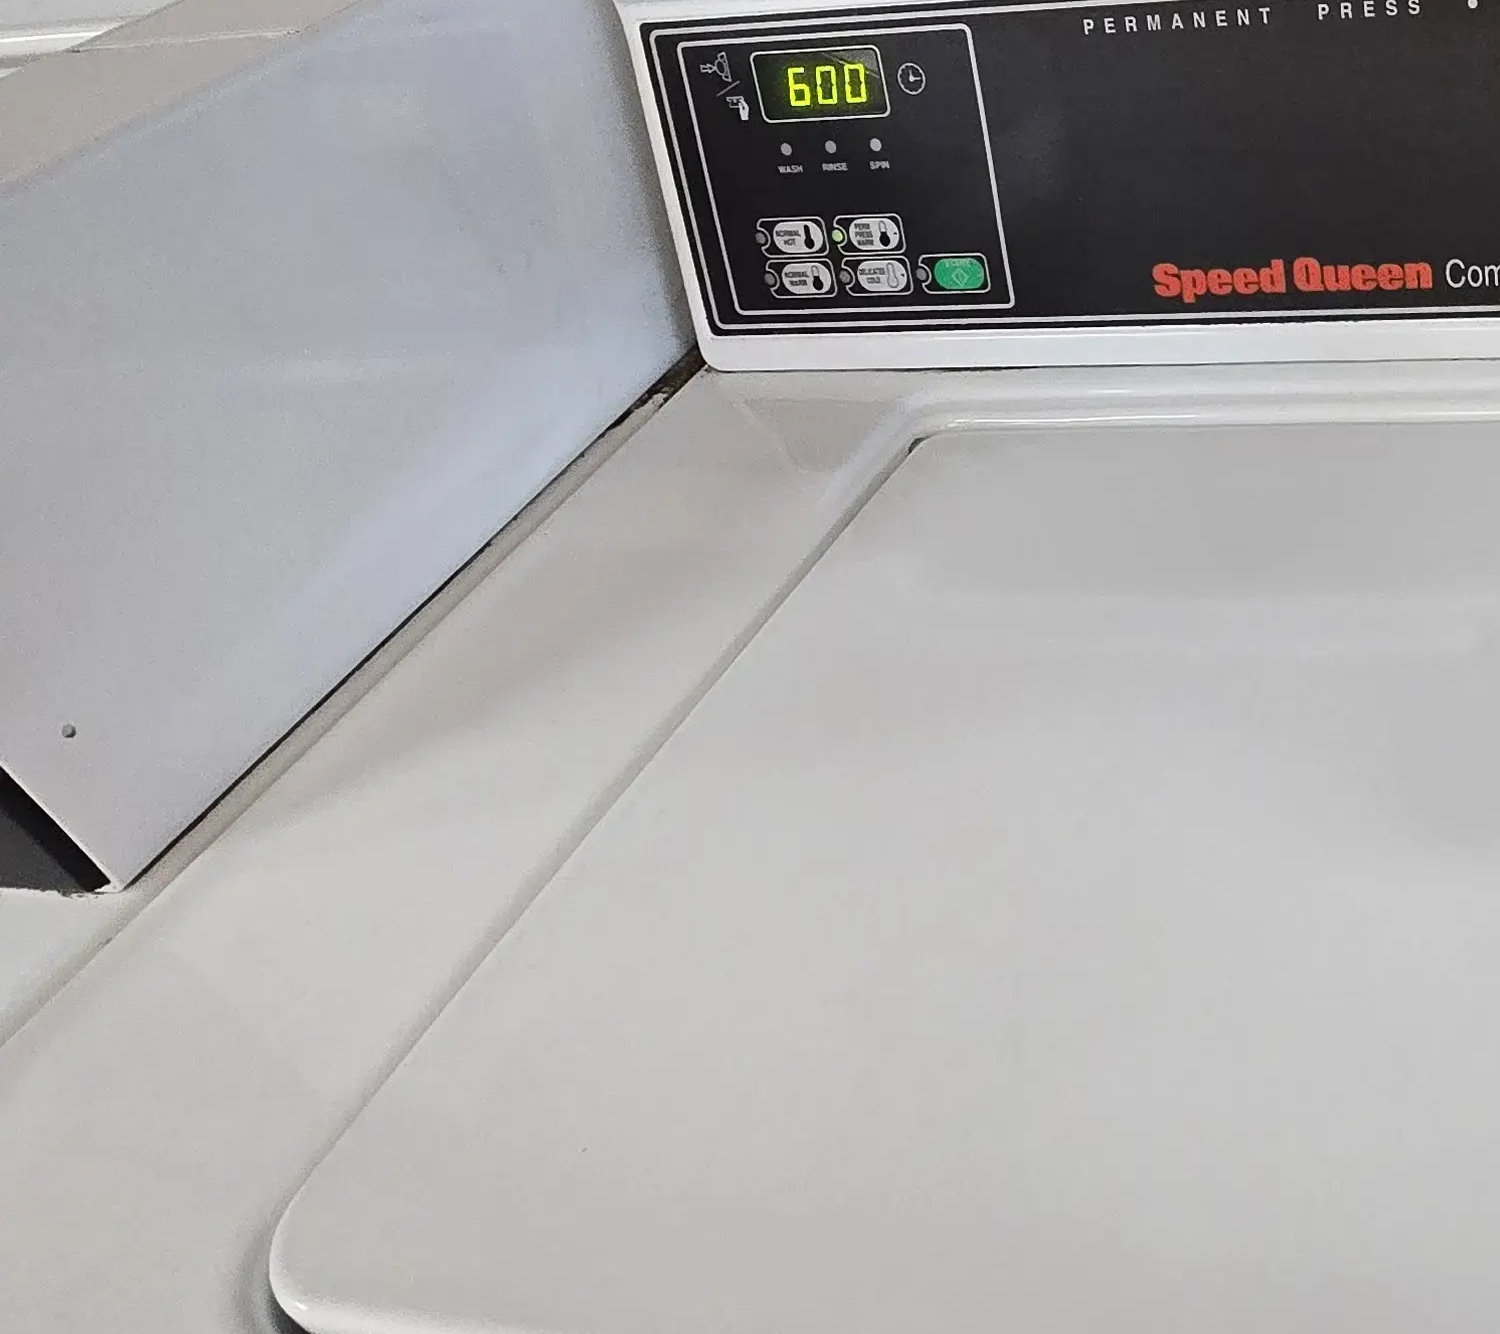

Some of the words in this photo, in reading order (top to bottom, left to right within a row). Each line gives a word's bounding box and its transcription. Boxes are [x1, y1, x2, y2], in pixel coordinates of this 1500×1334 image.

[1083, 7, 1271, 35] PERMANENT
[787, 63, 867, 106] 600
[869, 160, 890, 170] SPIN
[1152, 259, 1287, 304] Speed
[1293, 257, 1433, 292] Queen
